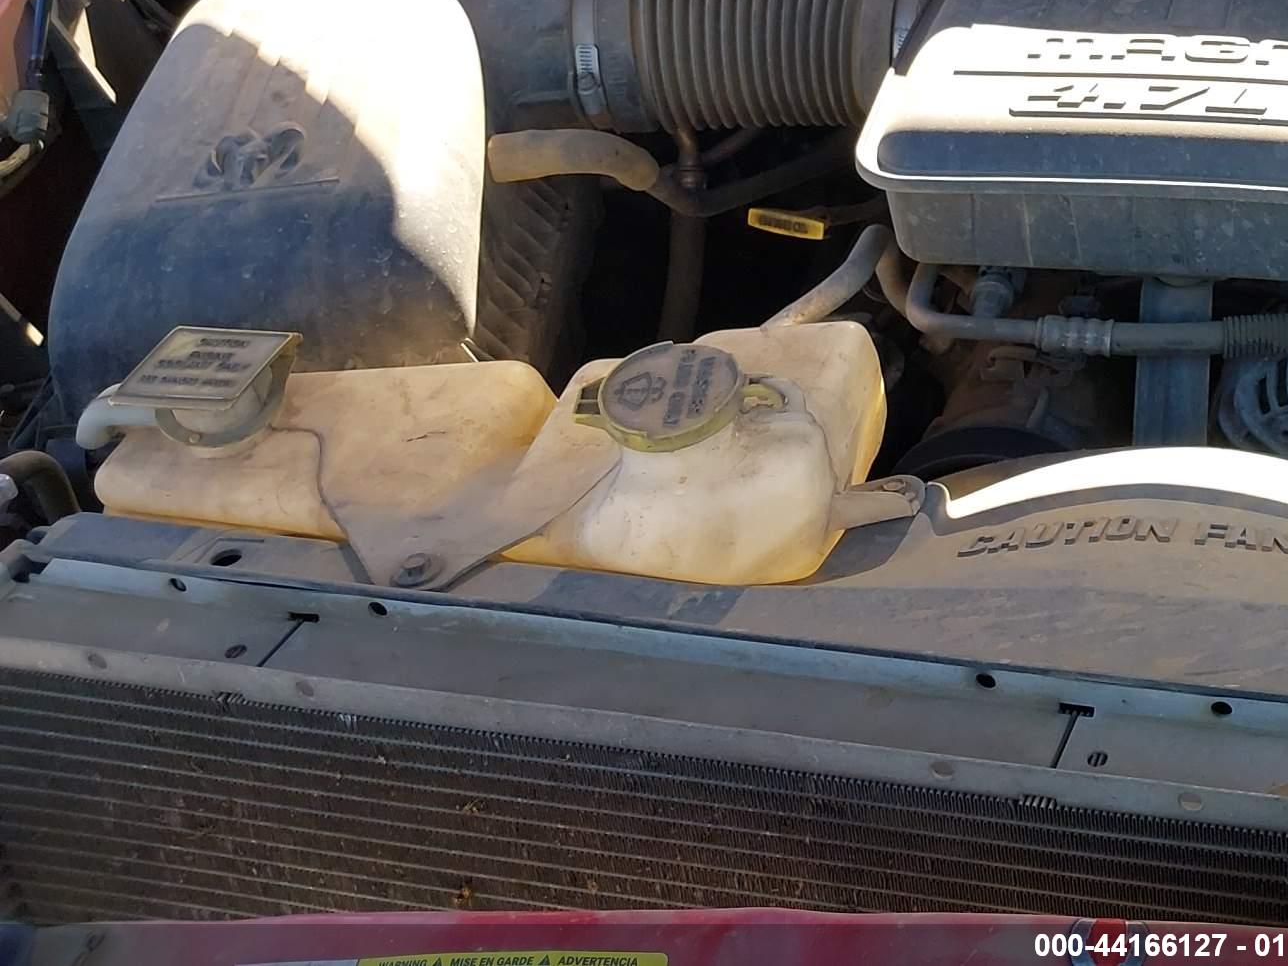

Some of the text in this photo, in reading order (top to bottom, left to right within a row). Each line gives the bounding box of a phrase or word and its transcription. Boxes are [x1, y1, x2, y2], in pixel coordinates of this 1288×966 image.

[1027, 82, 1269, 115] 4.7L
[957, 515, 1180, 558] CAUTION
[450, 957, 479, 966] MISE
[480, 957, 495, 966] EN
[497, 956, 535, 966] GARDE
[558, 956, 638, 966] ADVERTENCIA
